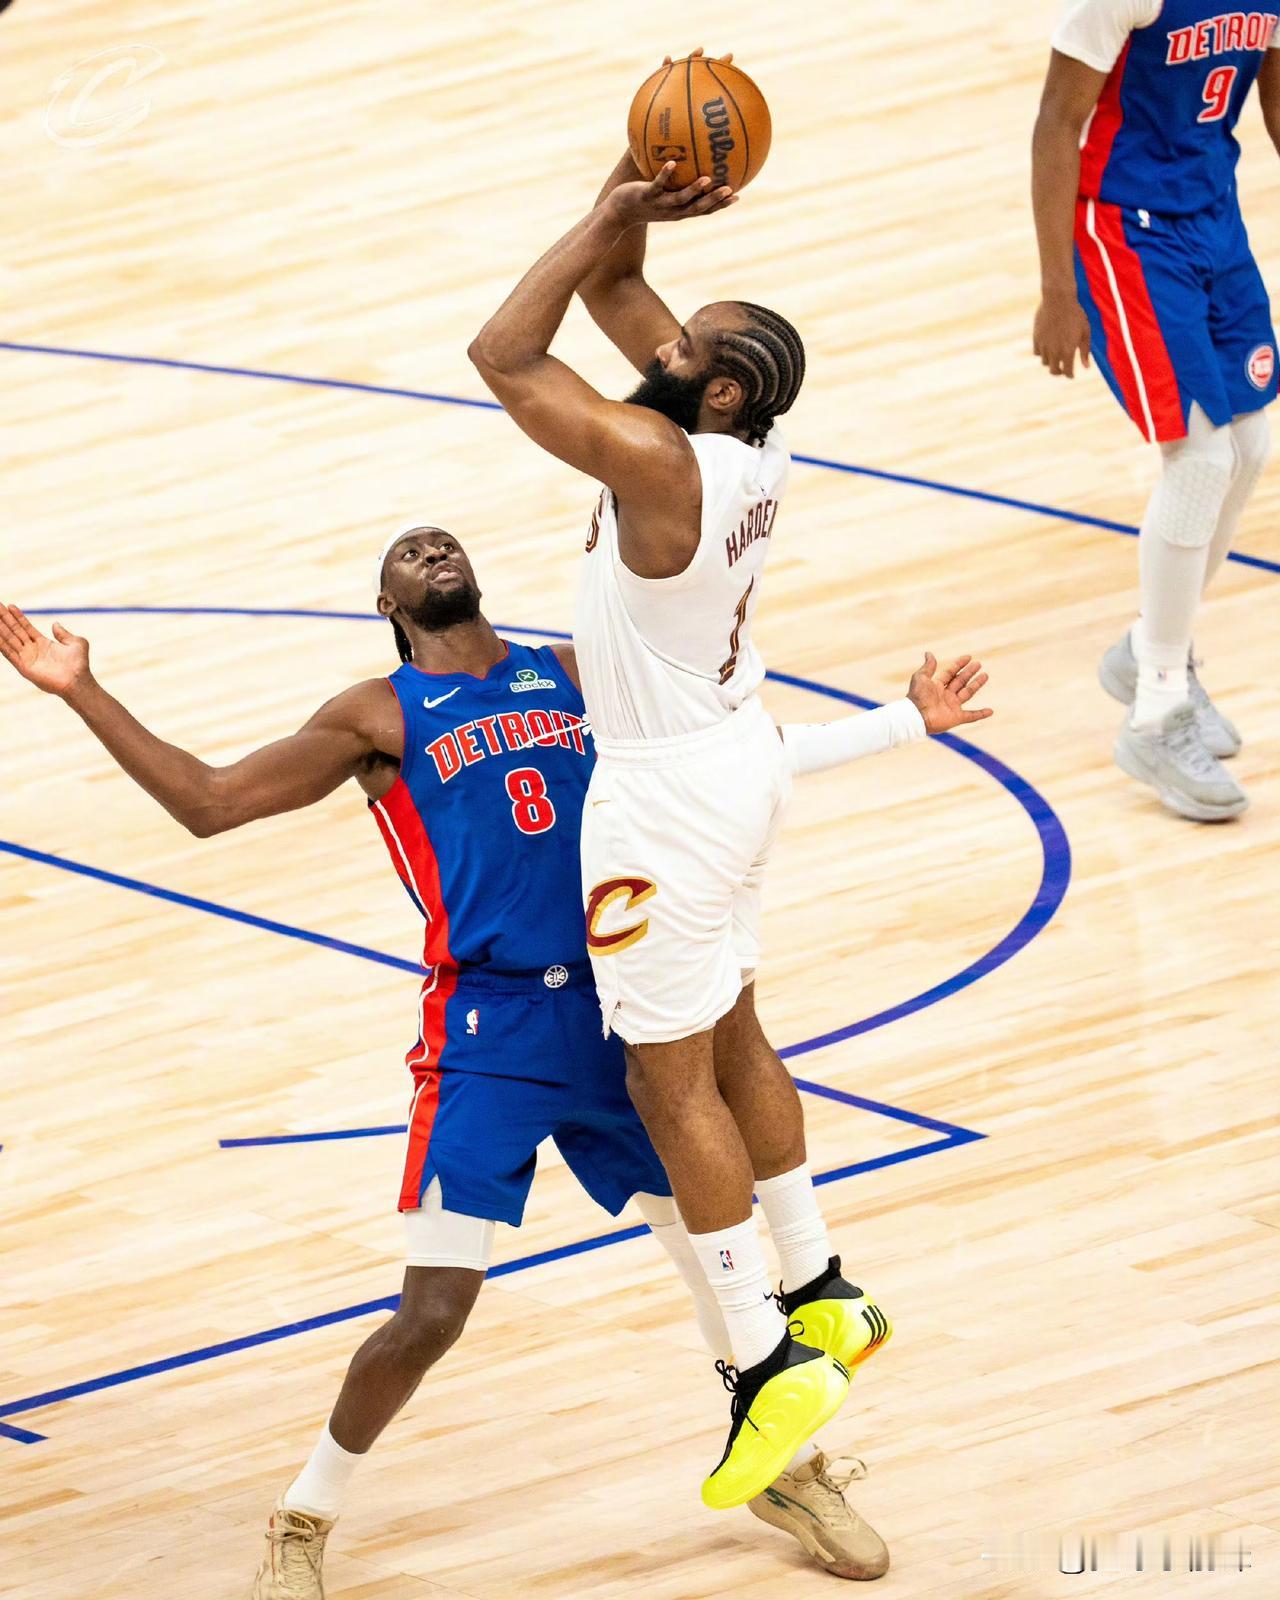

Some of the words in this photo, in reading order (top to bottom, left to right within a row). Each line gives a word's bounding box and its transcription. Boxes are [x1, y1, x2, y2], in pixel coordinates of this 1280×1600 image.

[1197, 66, 1238, 123] 9
[425, 709, 586, 784] DETROIT
[505, 767, 556, 835] 8
